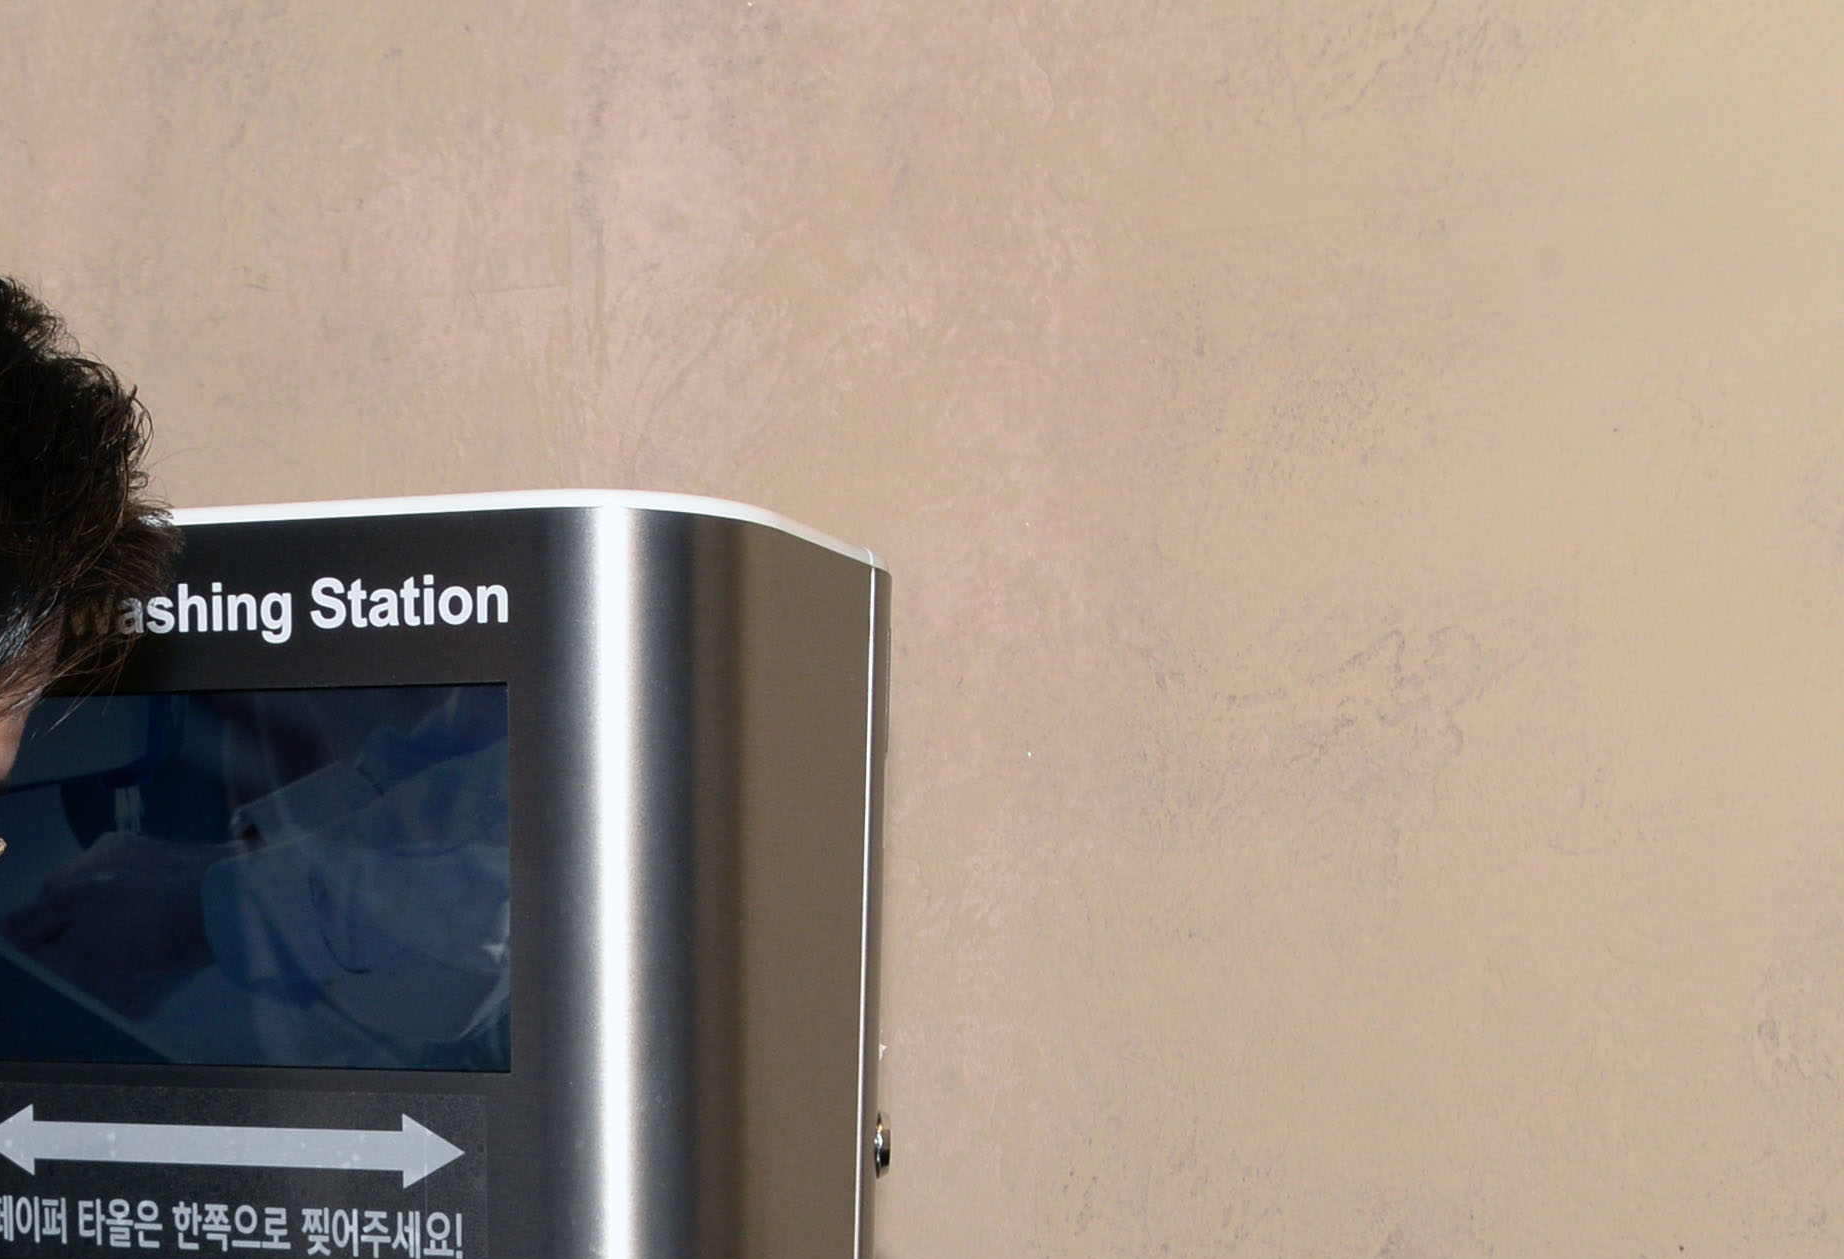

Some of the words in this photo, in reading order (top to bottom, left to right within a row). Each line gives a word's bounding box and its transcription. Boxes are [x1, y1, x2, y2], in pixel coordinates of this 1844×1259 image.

[310, 573, 509, 630] Station
[77, 1198, 164, 1249] 타올은
[171, 1200, 292, 1252] 한쪽으로
